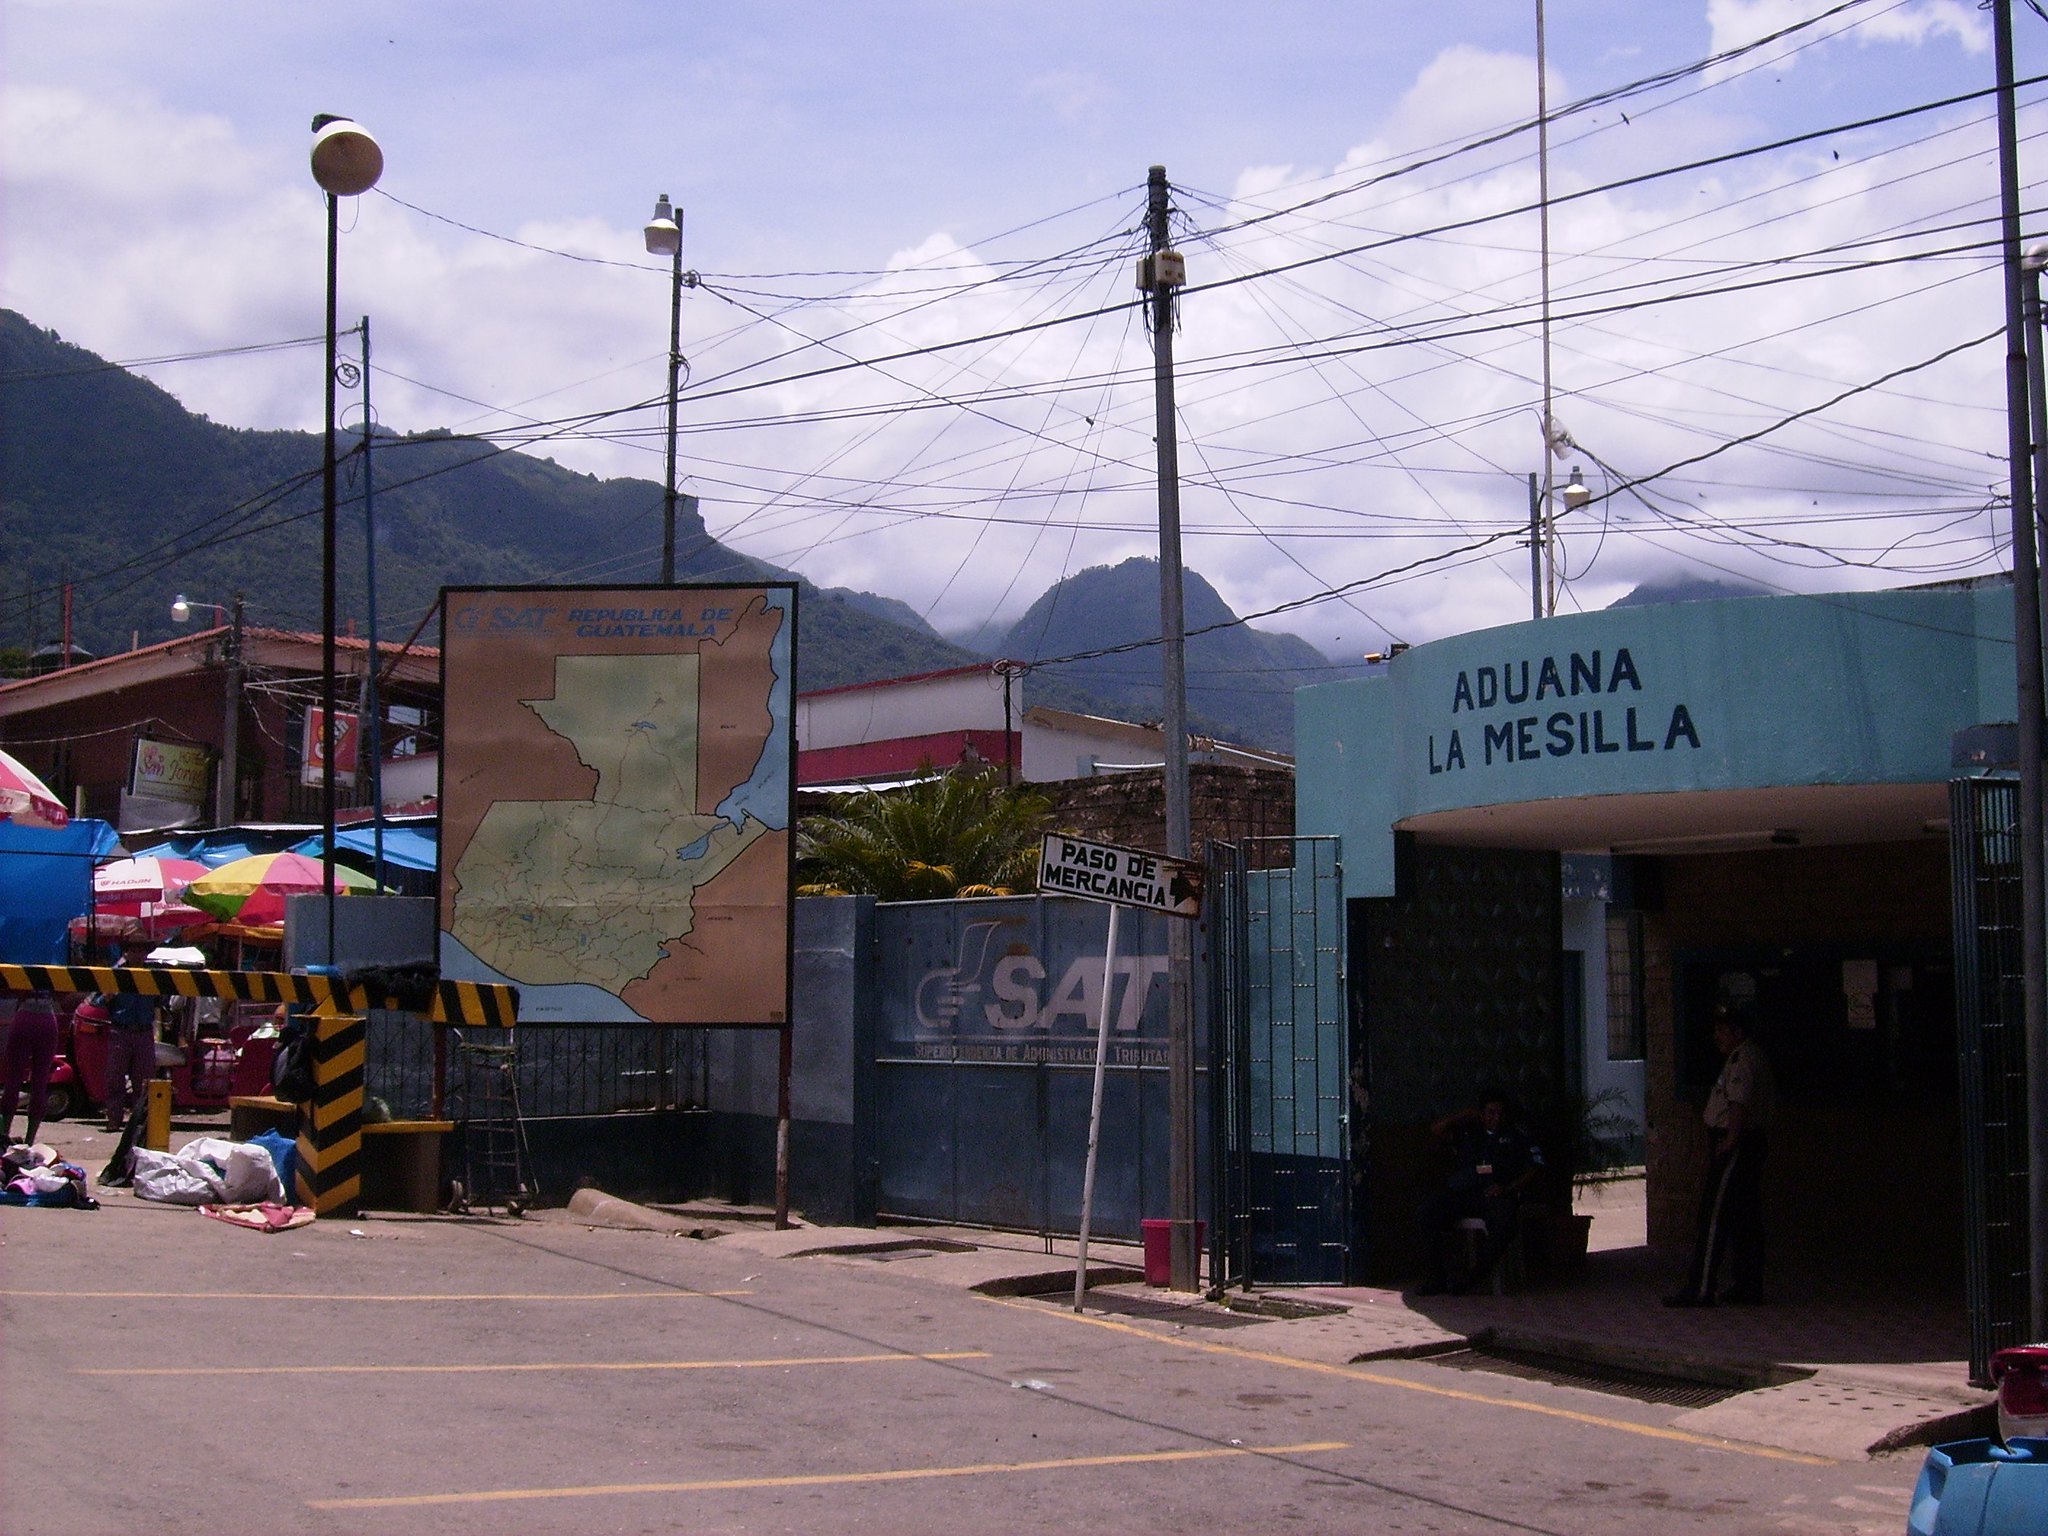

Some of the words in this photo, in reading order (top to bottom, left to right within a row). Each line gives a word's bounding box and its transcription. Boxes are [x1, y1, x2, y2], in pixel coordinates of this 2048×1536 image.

[568, 607, 682, 622] REPUBLICA
[700, 608, 733, 621] DE
[576, 624, 717, 638] GUATEMALA
[1452, 648, 1642, 714] ADUANA
[1429, 729, 1466, 775] LA
[1484, 704, 1701, 766] MESILLA
[1061, 843, 1118, 872] PASO
[1127, 856, 1157, 881] DE
[1045, 863, 1166, 907] MERCANCIA
[984, 955, 1170, 1031] SAT
[1023, 1044, 1100, 1063] ADMINISTRACIO
